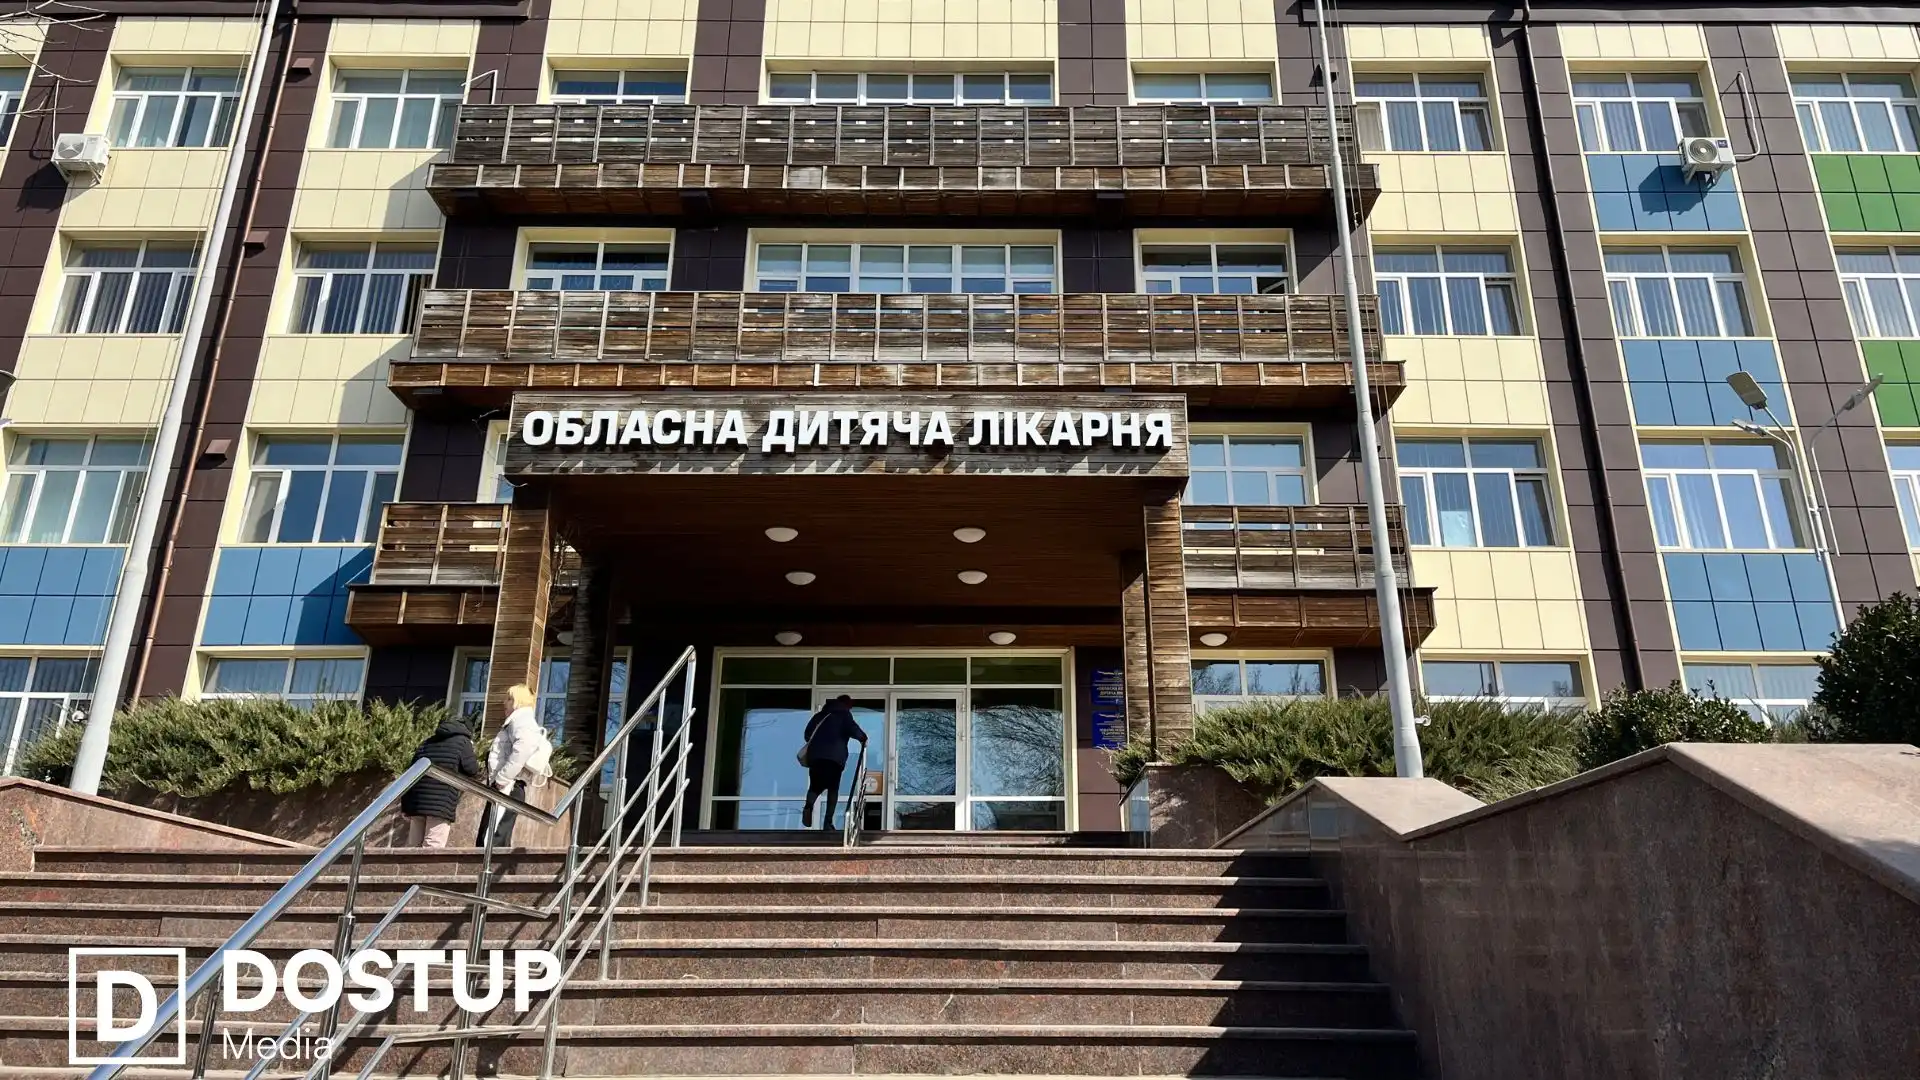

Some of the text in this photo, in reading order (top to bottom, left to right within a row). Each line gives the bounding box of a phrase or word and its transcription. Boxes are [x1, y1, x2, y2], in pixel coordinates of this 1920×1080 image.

[522, 410, 1176, 454] ОБЛАСНА ДИТЯЧА ЛІКАРНЯ
